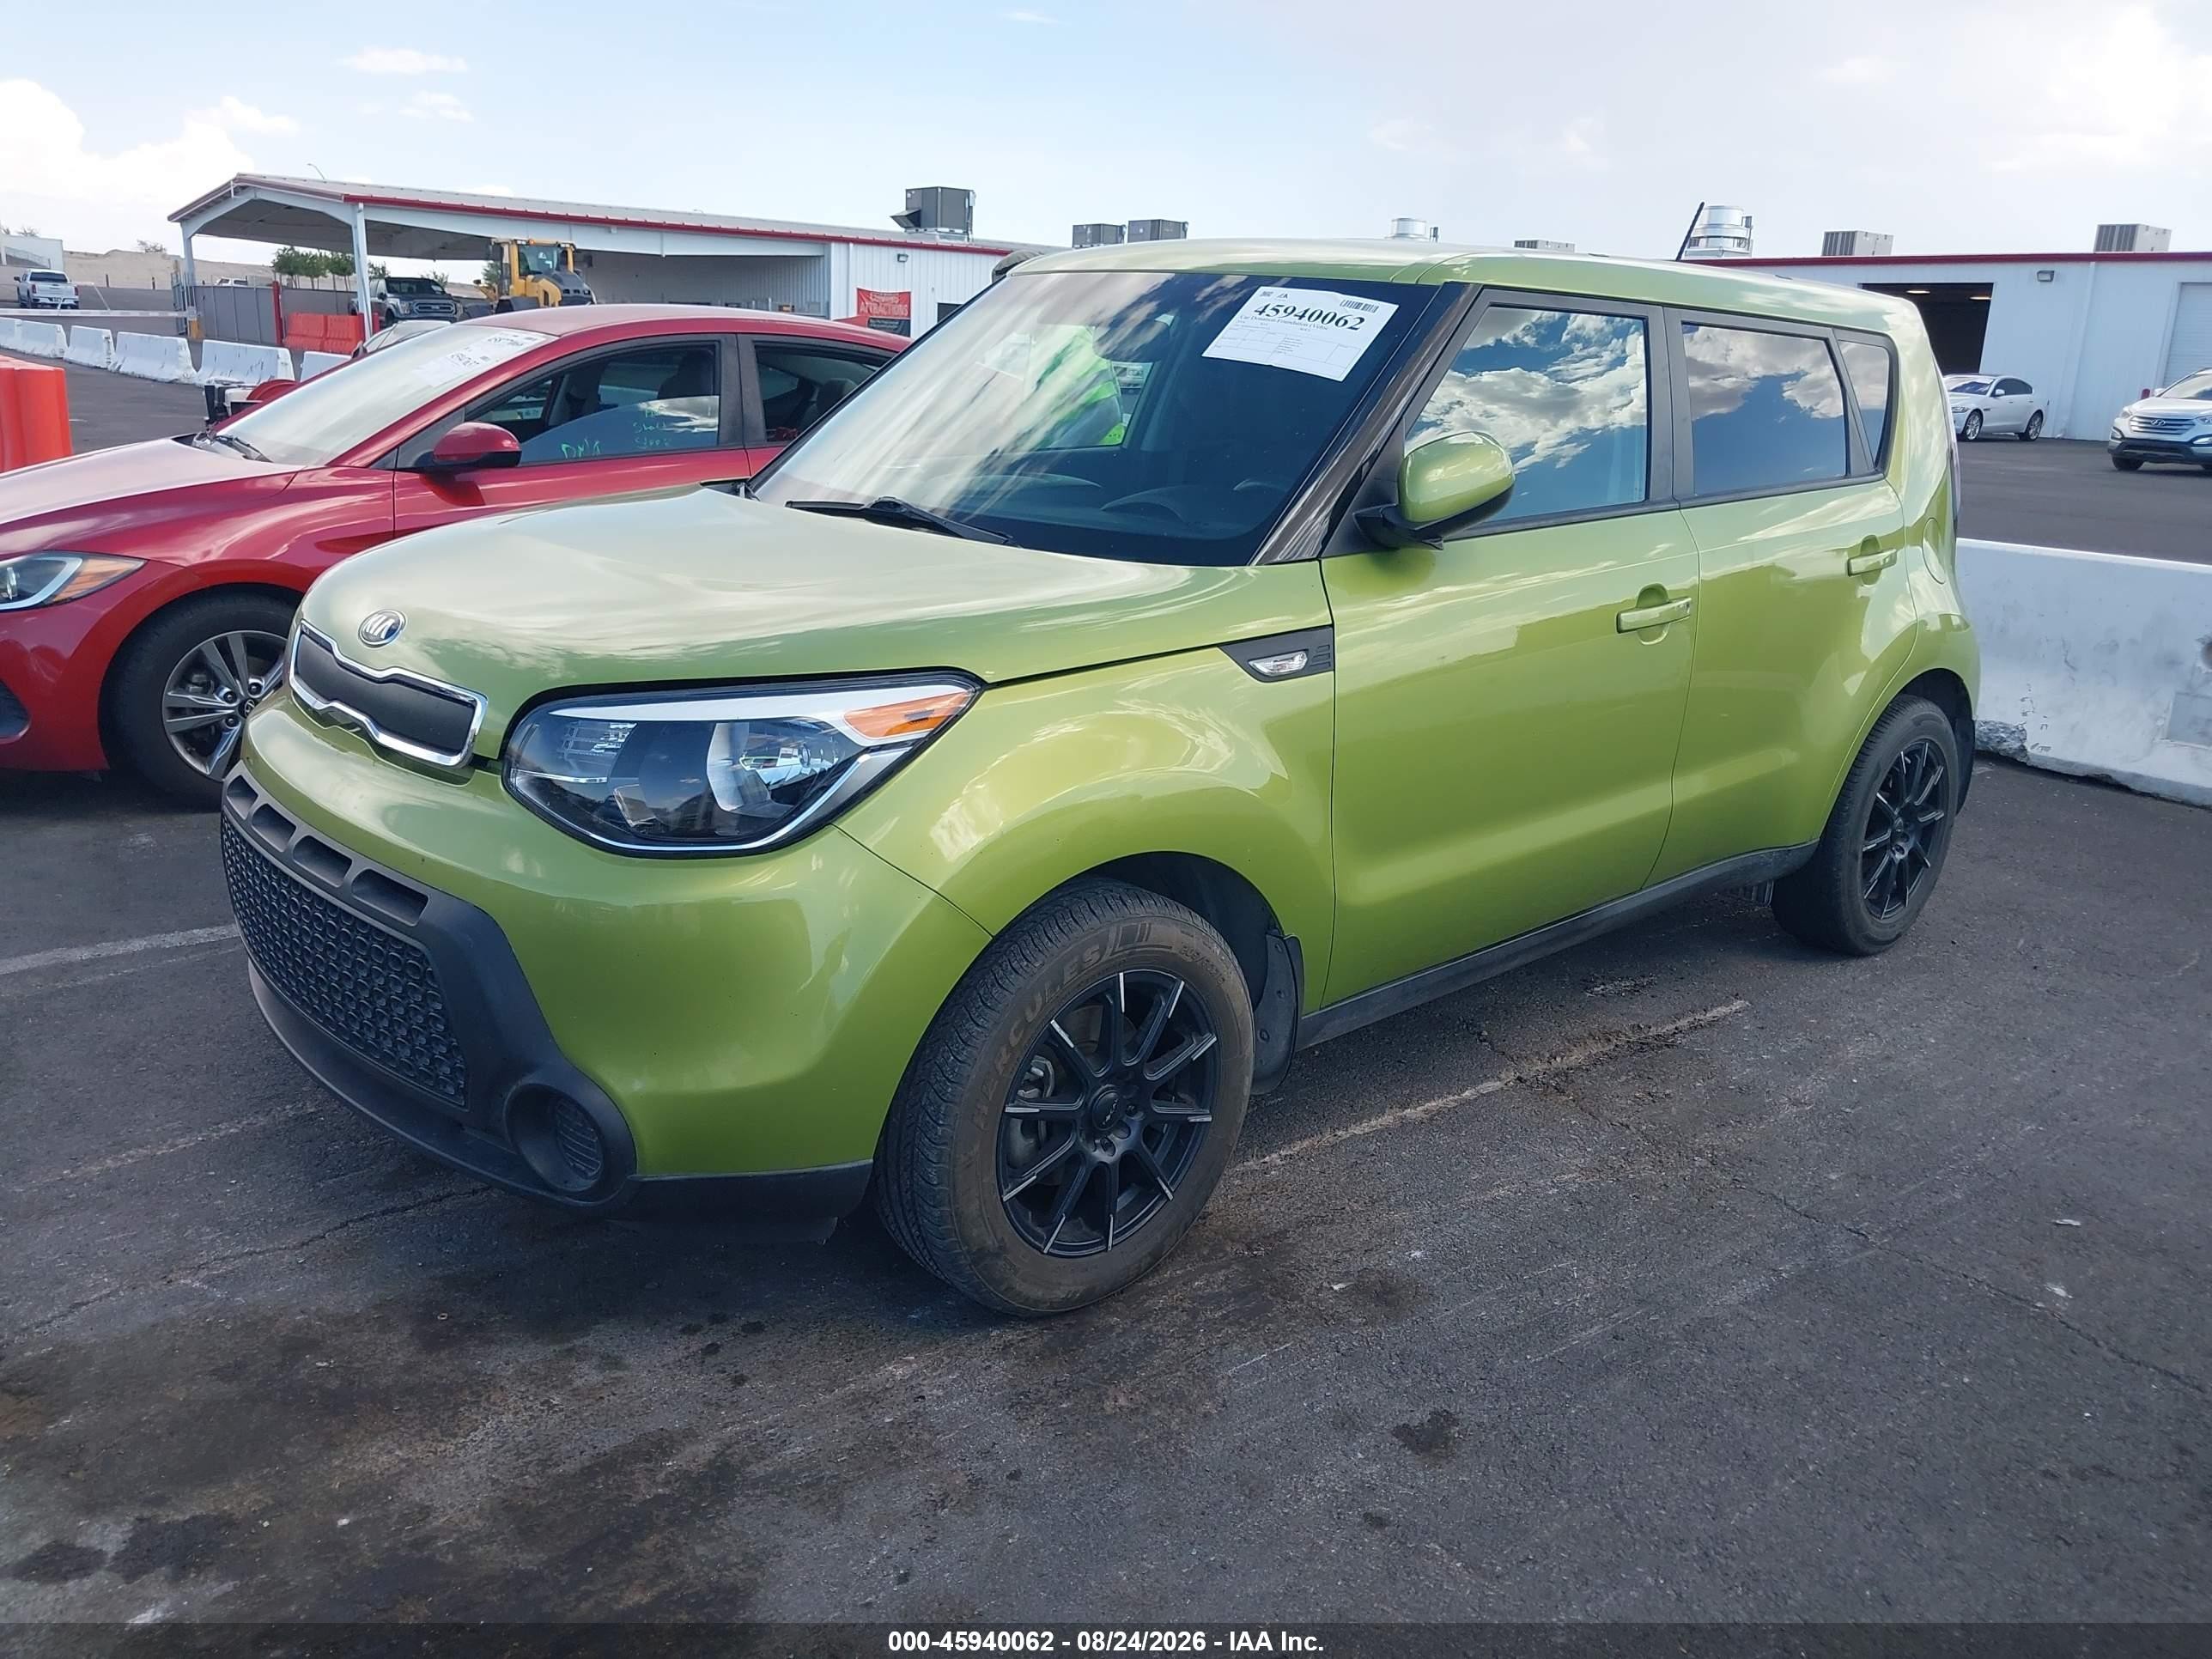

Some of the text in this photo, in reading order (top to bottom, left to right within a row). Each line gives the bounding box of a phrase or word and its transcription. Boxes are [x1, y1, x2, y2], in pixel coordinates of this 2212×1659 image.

[1254, 303, 1365, 331] 45940062
[363, 614, 396, 639] KIA
[974, 945, 1103, 1131] HERCULES
